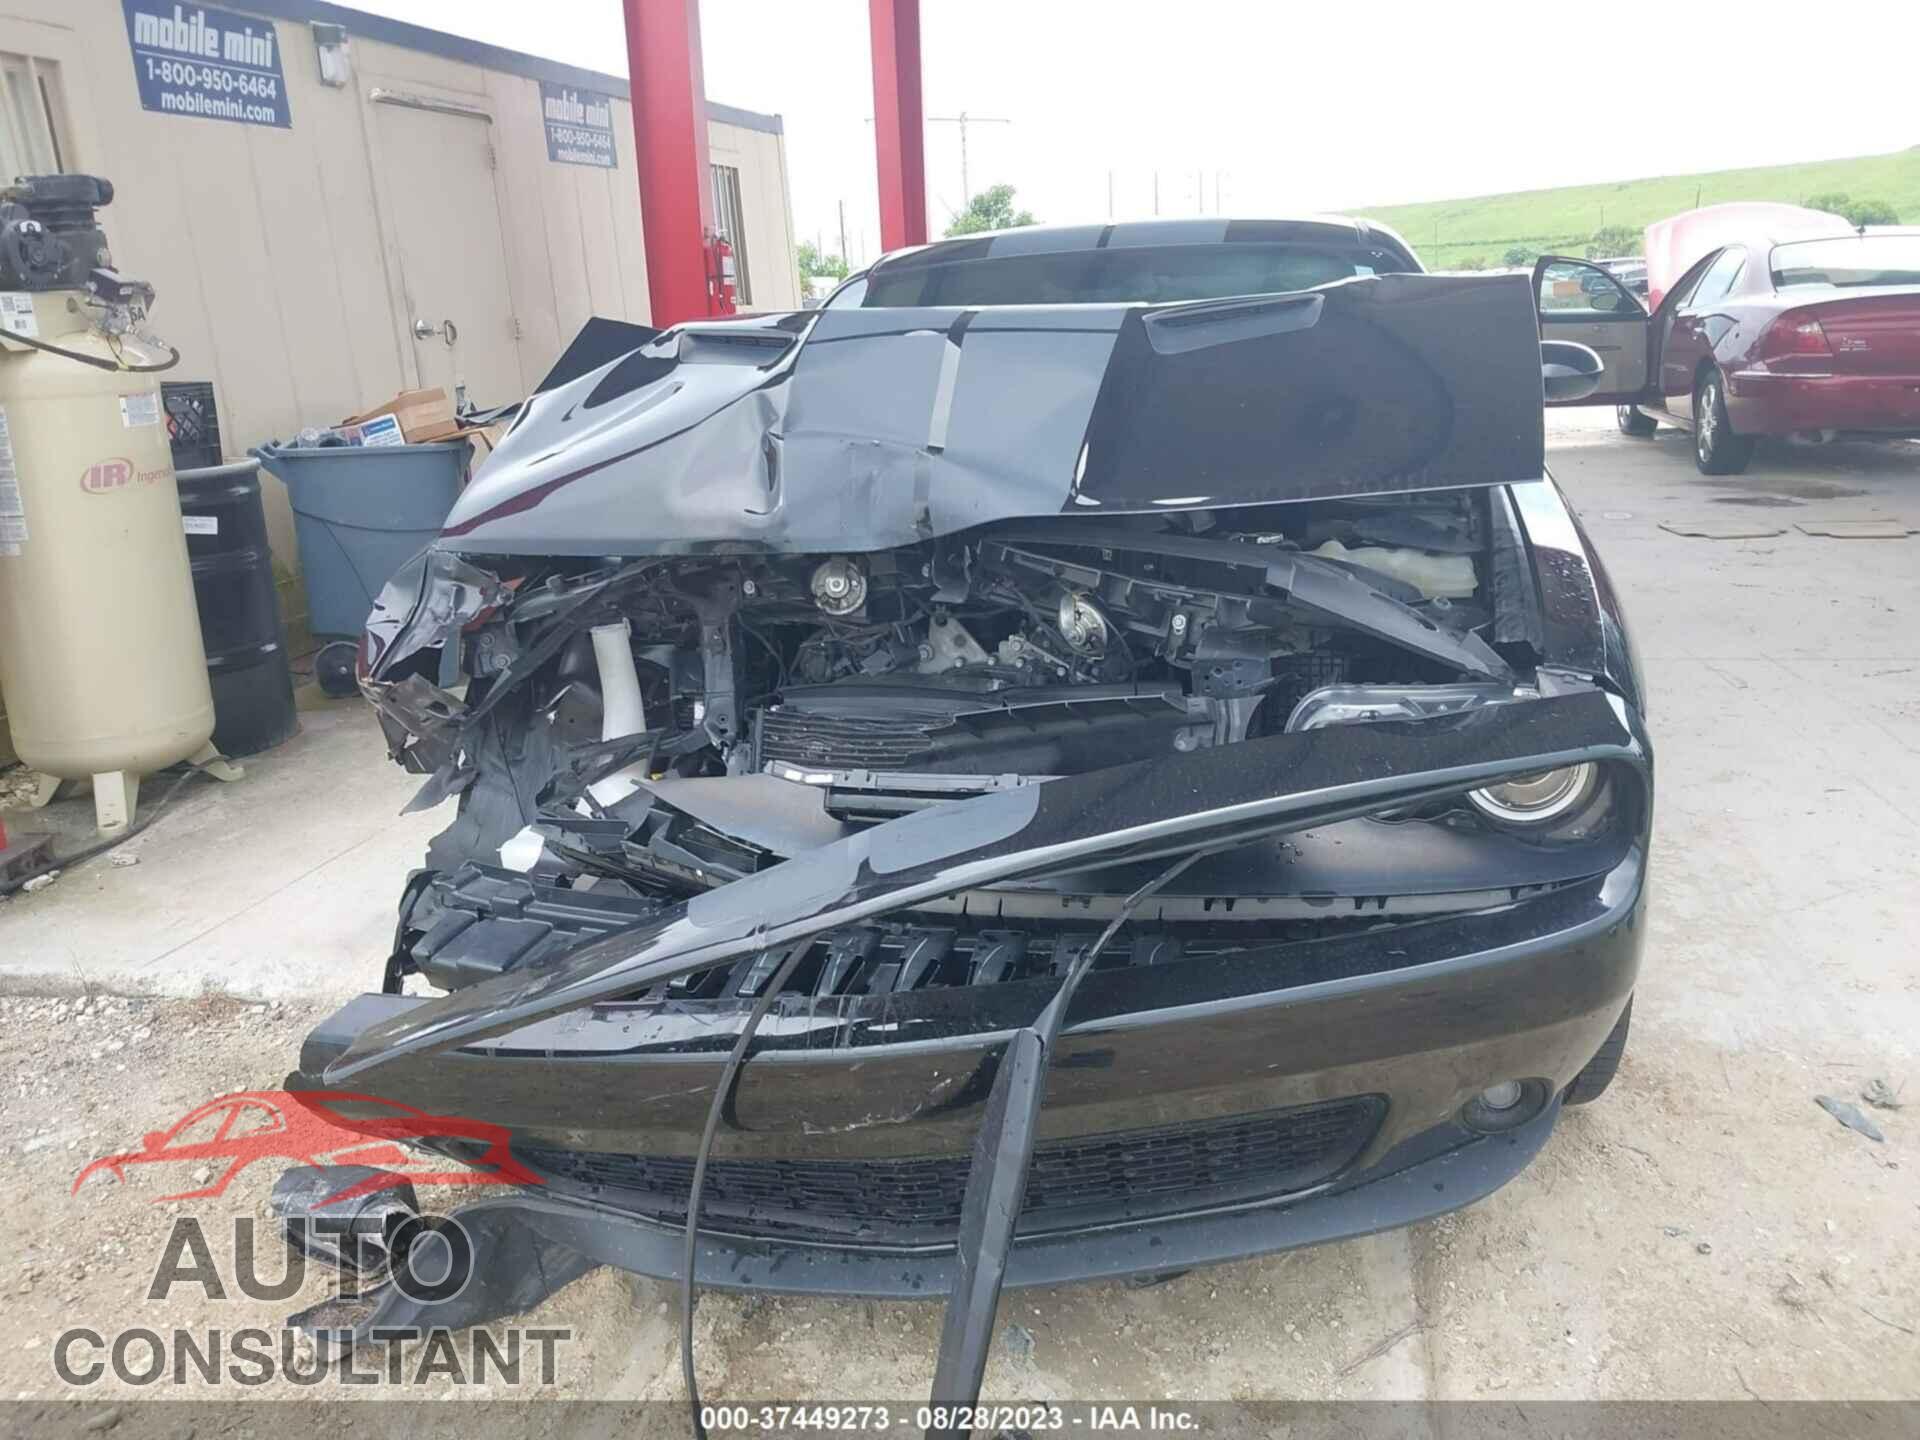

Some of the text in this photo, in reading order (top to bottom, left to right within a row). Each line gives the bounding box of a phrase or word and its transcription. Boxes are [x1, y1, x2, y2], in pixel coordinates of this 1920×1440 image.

[134, 5, 273, 68] mobile mini
[146, 58, 276, 99] 1-800-950-6464
[161, 91, 275, 122] mobilemini.com
[545, 89, 609, 128] mobile mini
[558, 147, 610, 166] mobilemini.com
[90, 463, 126, 488] IR
